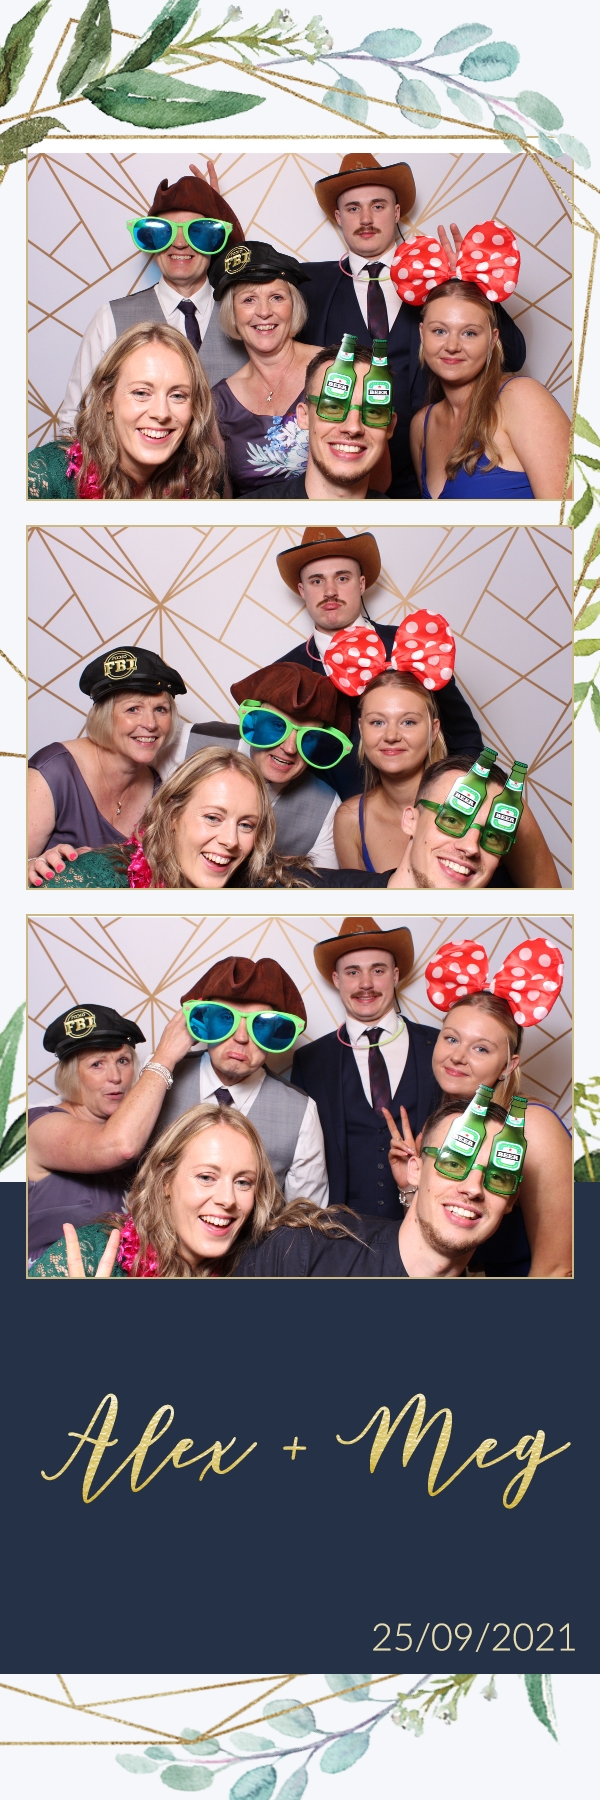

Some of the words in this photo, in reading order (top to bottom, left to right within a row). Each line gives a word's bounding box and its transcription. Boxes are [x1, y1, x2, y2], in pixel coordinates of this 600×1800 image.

[225, 251, 251, 272] FBI
[104, 657, 137, 676] FBI
[495, 812, 516, 824] BEER
[64, 1015, 96, 1035] FBI
[497, 1151, 520, 1161] BEER
